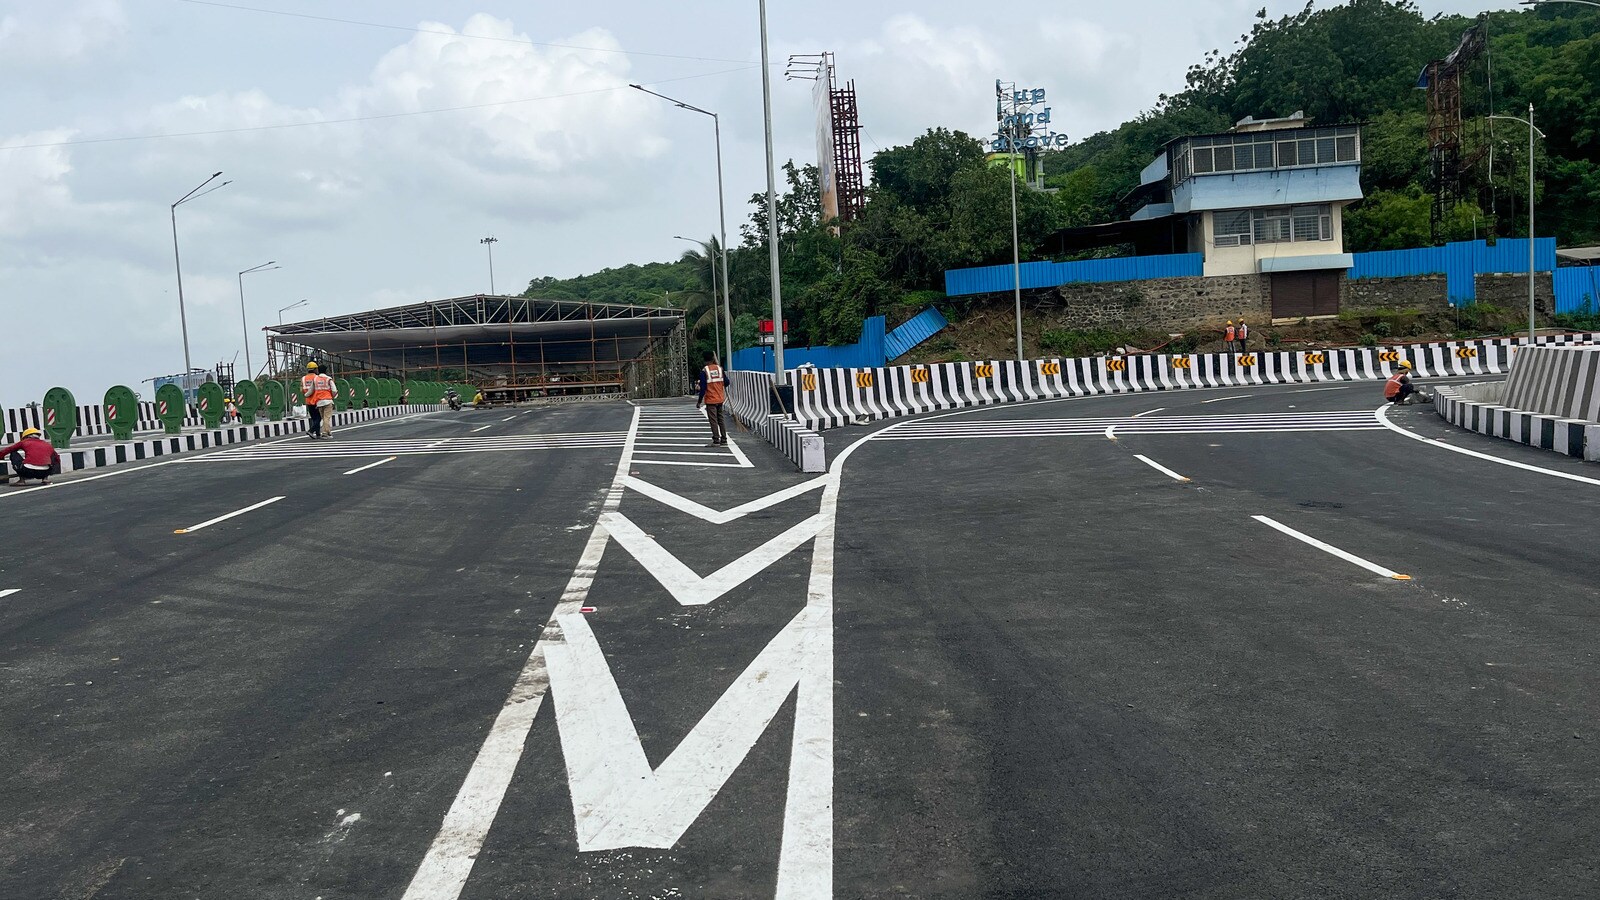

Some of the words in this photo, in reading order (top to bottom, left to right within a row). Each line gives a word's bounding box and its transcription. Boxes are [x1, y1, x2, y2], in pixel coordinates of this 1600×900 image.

[1013, 88, 1045, 105] up
[1004, 107, 1051, 126] and
[992, 131, 1068, 150] above
